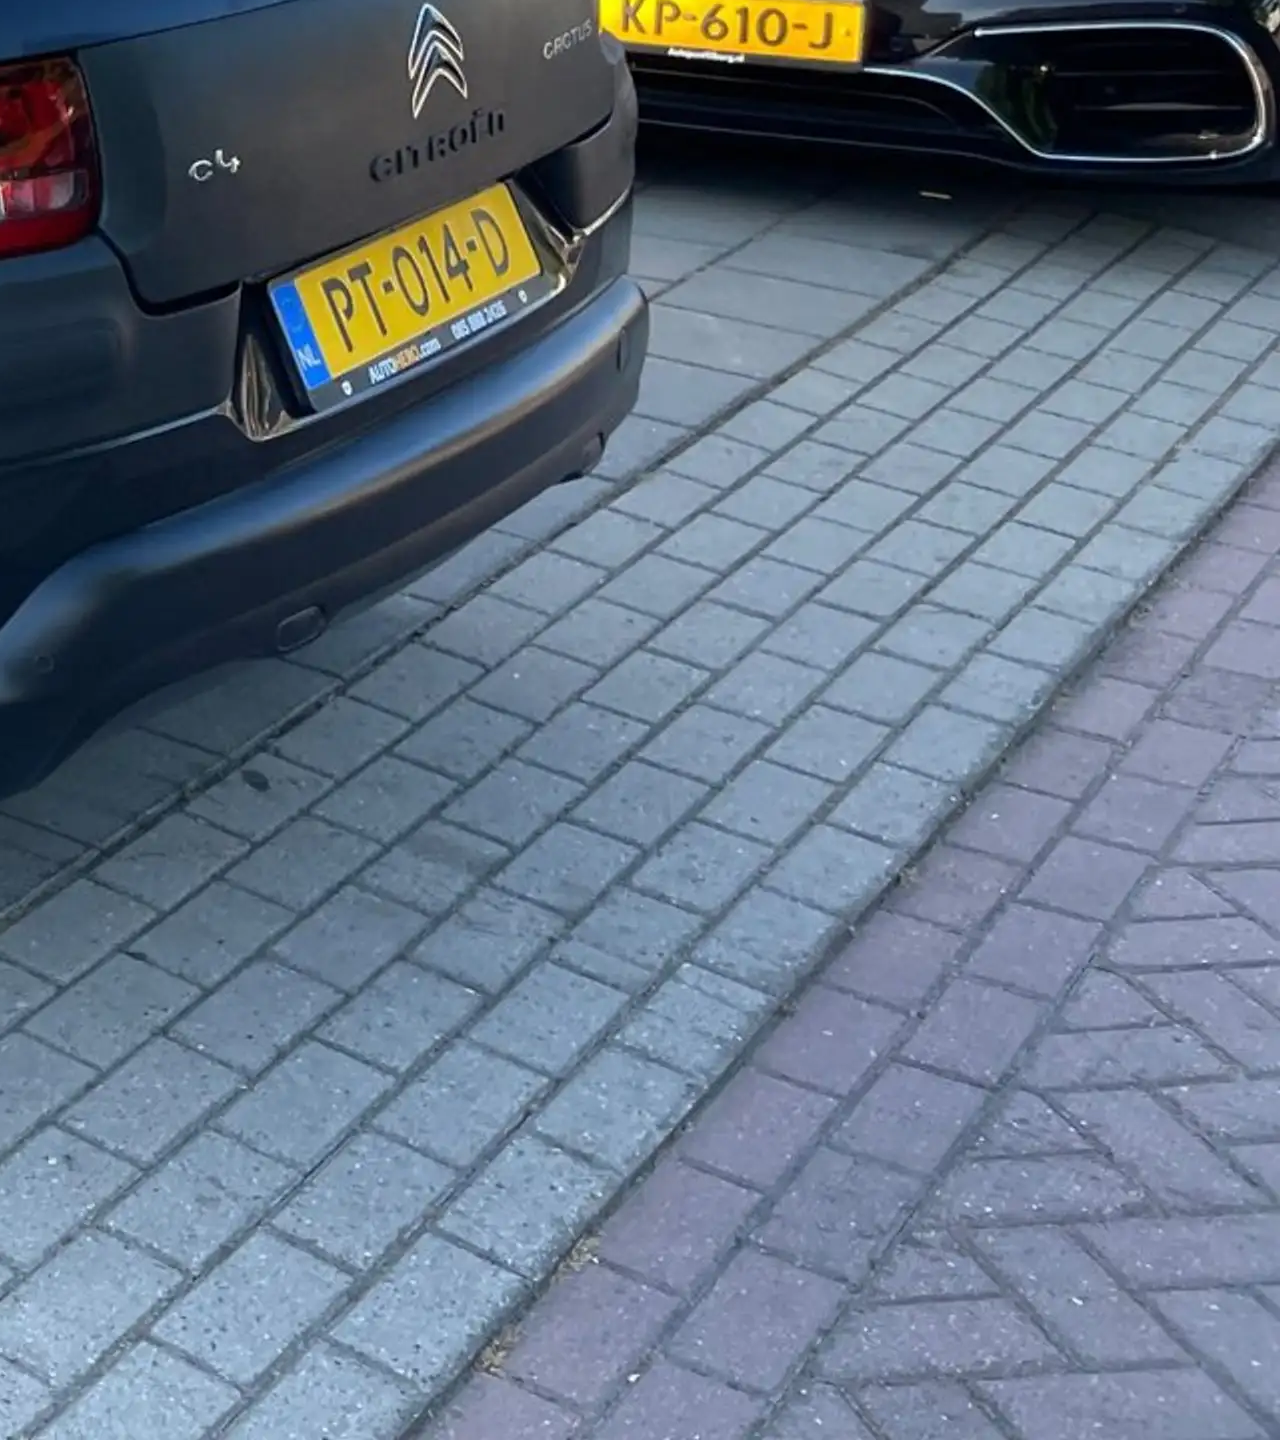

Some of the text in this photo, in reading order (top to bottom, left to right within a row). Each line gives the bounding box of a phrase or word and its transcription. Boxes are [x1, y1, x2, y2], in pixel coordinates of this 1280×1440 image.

[543, 18, 593, 60] CACTUS
[188, 149, 241, 181] C4
[320, 208, 510, 353] PT-014-D
[297, 341, 321, 371] NL
